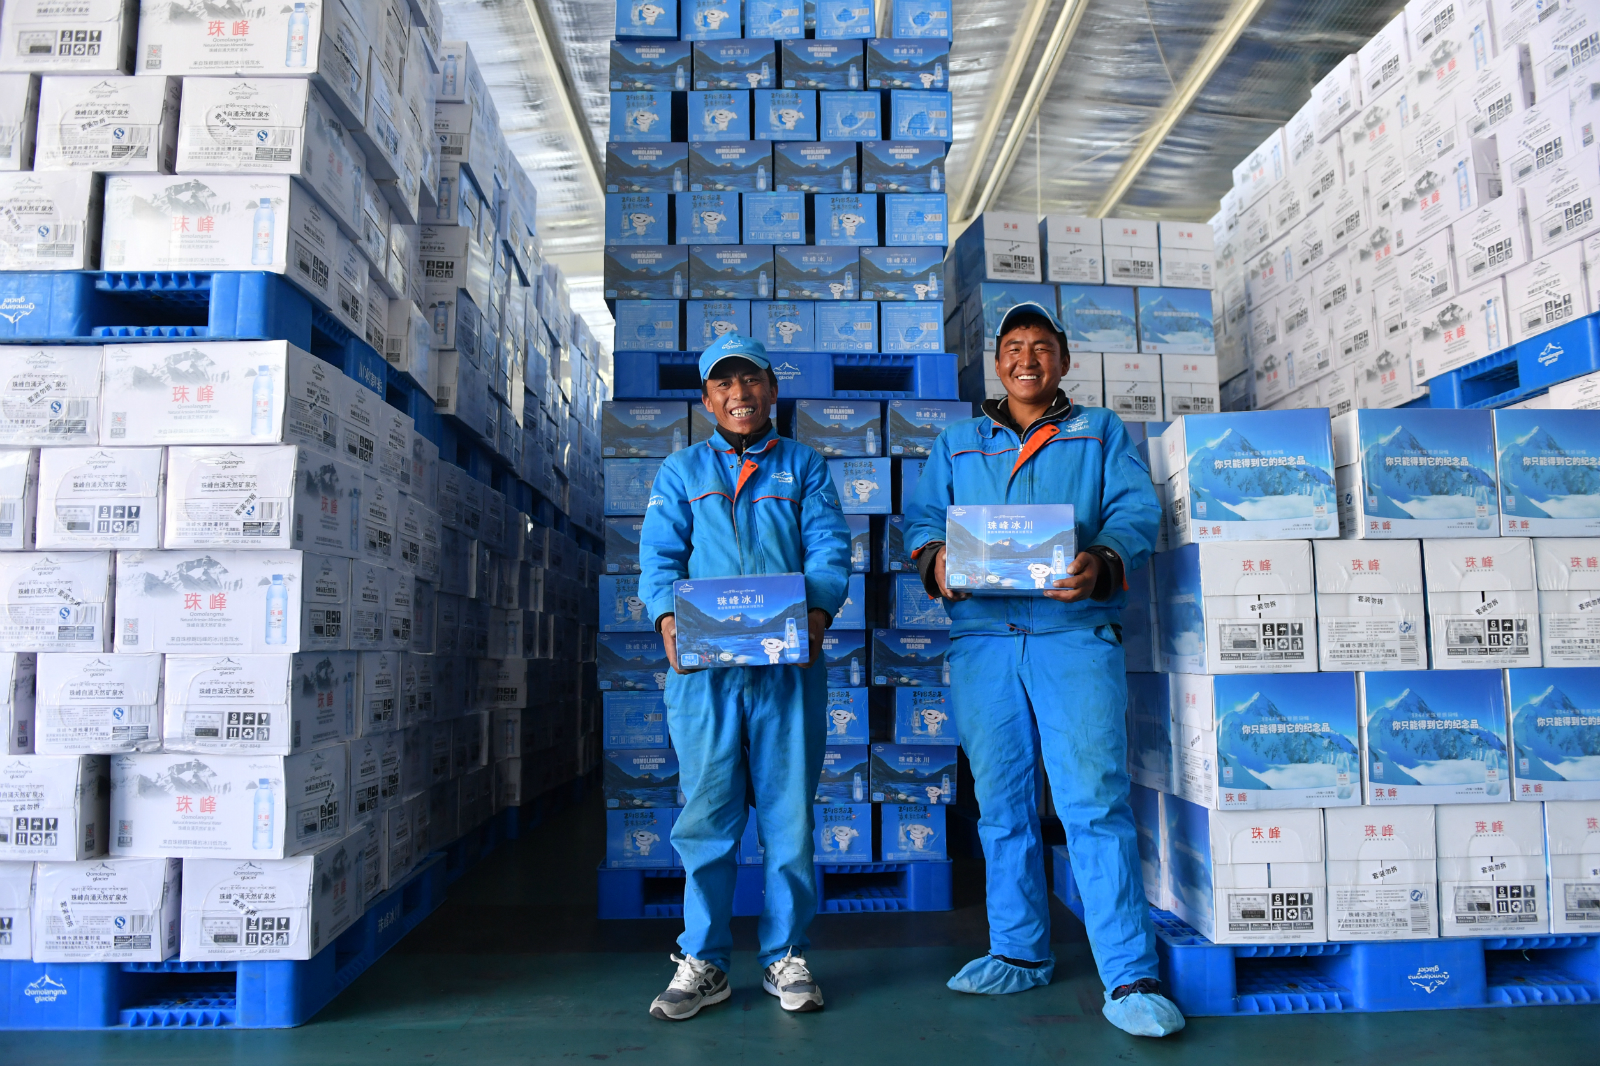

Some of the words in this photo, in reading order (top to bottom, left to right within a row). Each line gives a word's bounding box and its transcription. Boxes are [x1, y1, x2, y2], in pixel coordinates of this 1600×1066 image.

[207, 20, 250, 37] 珠峰
[1436, 58, 1456, 80] 珠峰
[1420, 190, 1440, 210] 珠峰
[172, 216, 215, 233] 珠峰
[1444, 324, 1466, 343] 珠峰
[172, 385, 215, 403] 珠峰
[1214, 456, 1306, 469] 你只能得到它的纪念品
[1385, 456, 1469, 466] 你只能得到它的纪念品
[234, 493, 257, 516] 套装勿拆
[988, 521, 1033, 530] 珠峰冰川
[1199, 526, 1222, 536] 珠峰
[1370, 520, 1392, 530] 珠峰
[1508, 520, 1530, 530] 珠峰
[1242, 560, 1271, 572] 珠峰
[1352, 559, 1380, 571] 珠峰
[1465, 556, 1494, 568] 珠峰
[1570, 556, 1599, 568] 珠峰
[184, 592, 227, 611] 珠峰
[717, 594, 764, 606] 珠峰冰川
[1250, 600, 1277, 611] 套装勿拆
[1358, 596, 1383, 605] 套装勿拆
[1475, 599, 1499, 615] 套装勿拆
[1242, 723, 1331, 735] 你只能得到它的纪念品
[1392, 719, 1479, 730] 你只能得到它的纪念品
[1375, 788, 1397, 798] 珠峰
[1522, 784, 1543, 793] 珠峰
[1225, 793, 1247, 802] 珠峰
[13, 803, 40, 812] 套装勿拆
[176, 795, 217, 814] 珠峰
[1251, 826, 1281, 839] 珠峰
[1365, 824, 1394, 837] 珠峰
[1475, 821, 1504, 833] 珠峰
[1372, 866, 1398, 880] 套装勿拆
[1481, 862, 1507, 874] 套装勿拆
[1418, 965, 1439, 973] glacier
[24, 988, 67, 996] Qomolangma
[35, 995, 57, 1003] glacier
